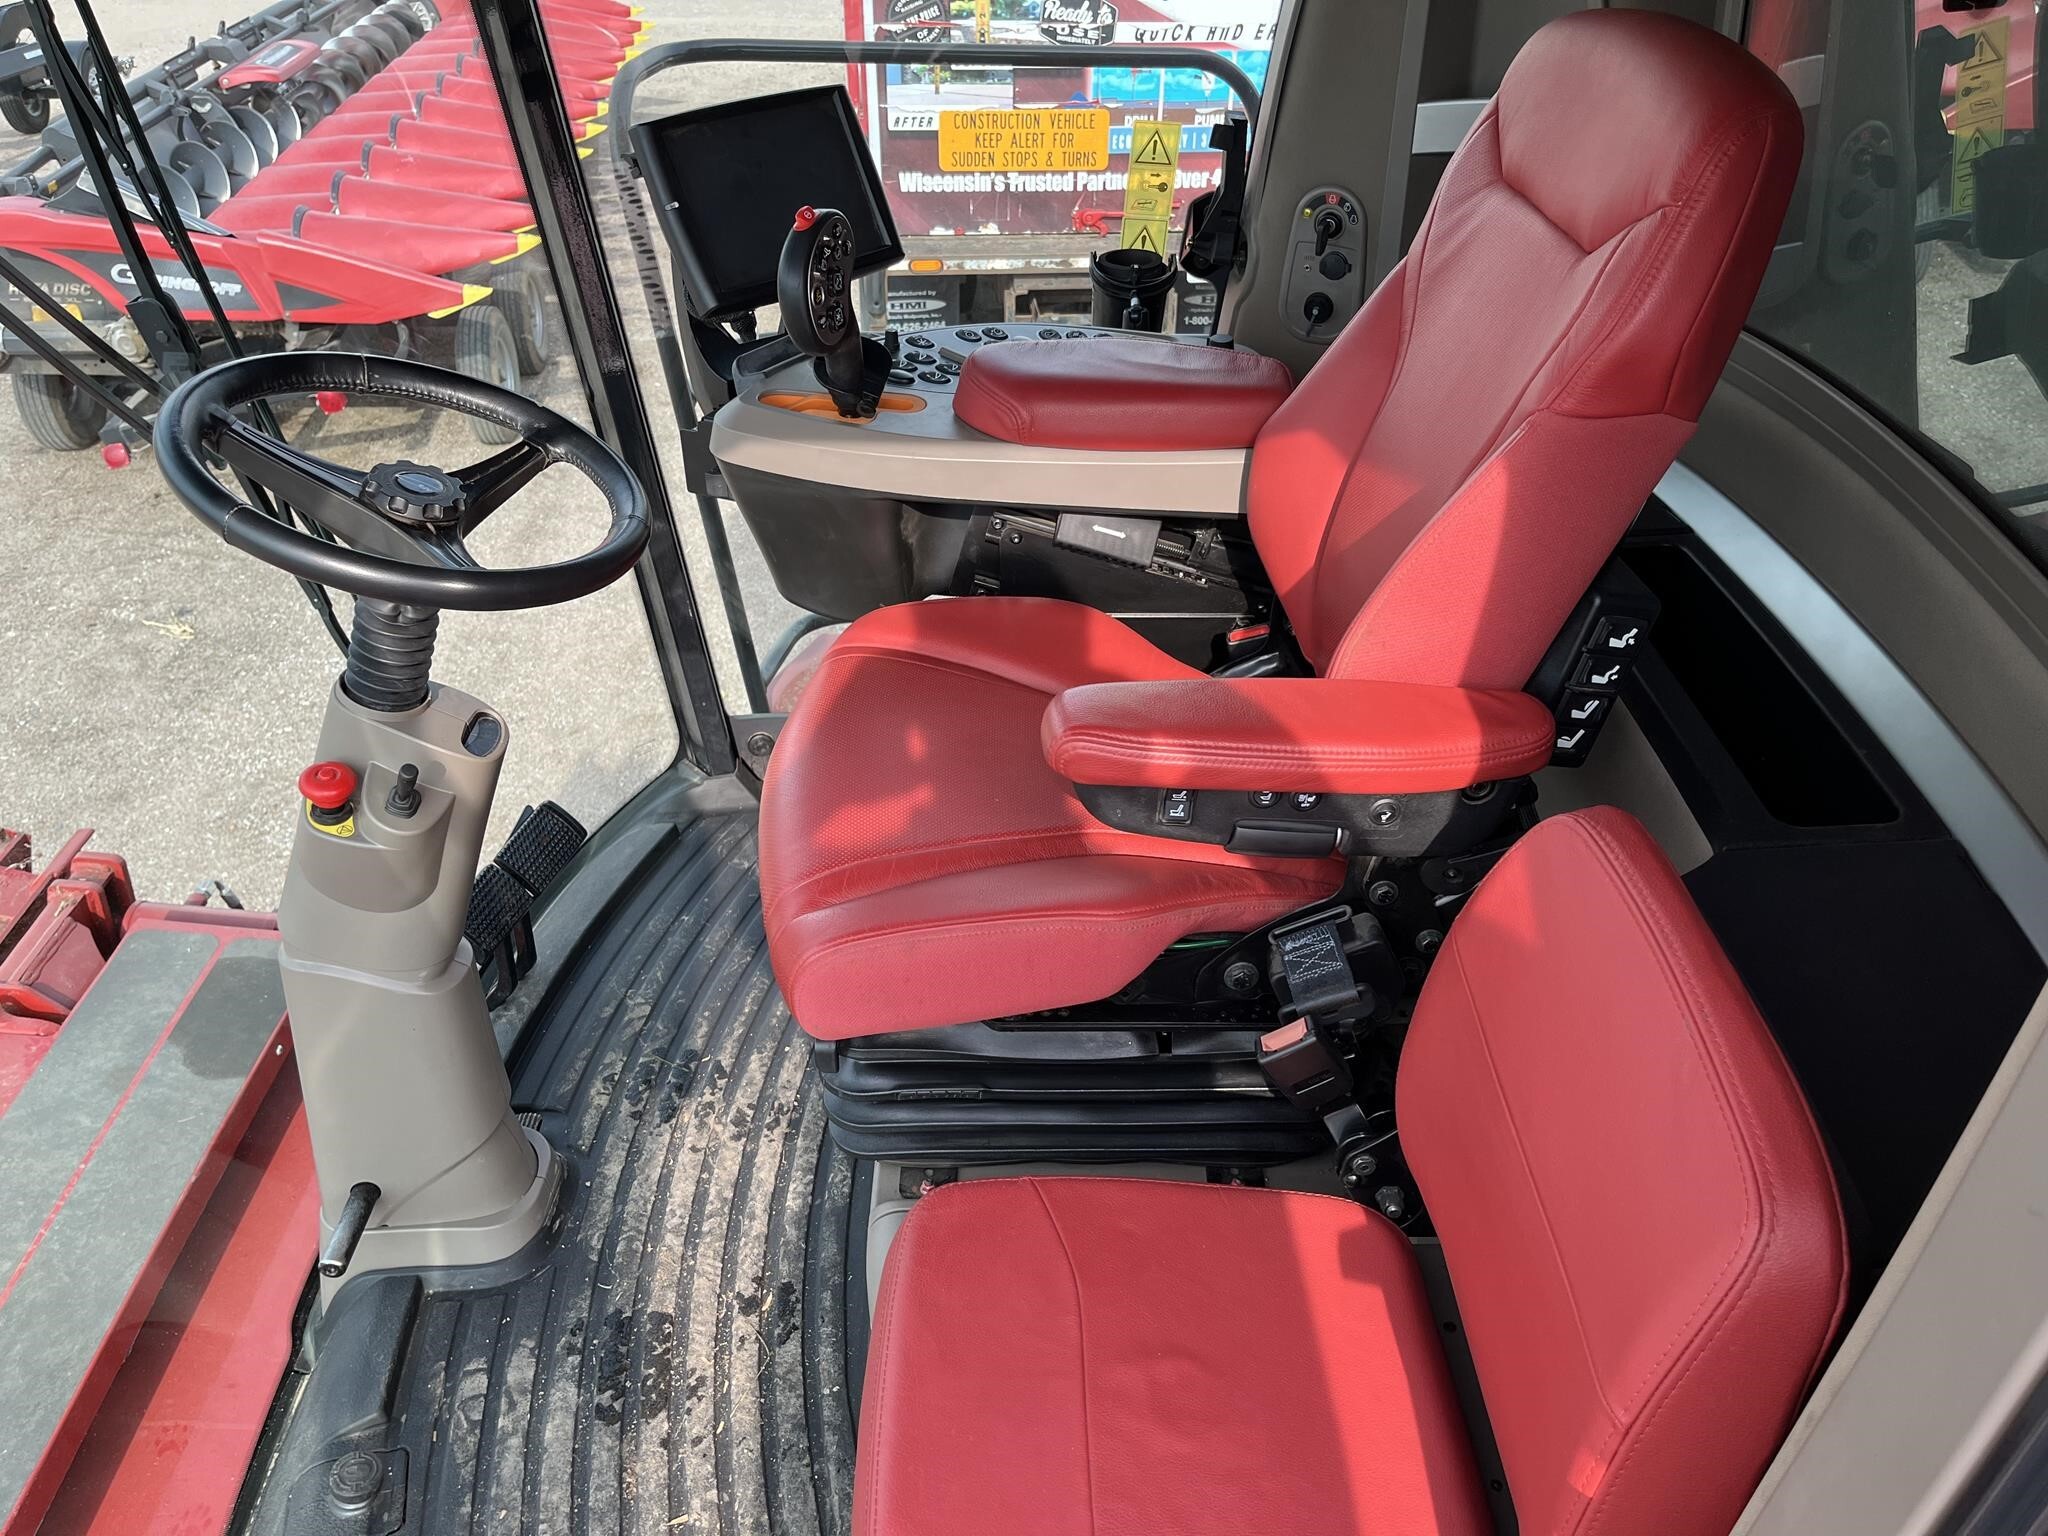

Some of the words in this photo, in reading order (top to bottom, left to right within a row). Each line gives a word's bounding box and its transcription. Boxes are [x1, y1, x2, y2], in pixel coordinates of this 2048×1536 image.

[919, 5, 941, 20] PRICE
[1044, 0, 1094, 25] Ready
[1097, 3, 1114, 26] to
[917, 28, 929, 39] OF
[1135, 24, 1196, 43] QUICK
[1253, 23, 1277, 41] EA
[894, 116, 934, 127] AFTER
[954, 113, 1040, 130] CONSTRUCTION
[1050, 113, 1096, 130] VEHICLE
[975, 132, 1003, 148] KEEP
[1010, 132, 1045, 148] ALERT
[1053, 132, 1074, 148] FOR
[951, 151, 995, 167] SUDDEN
[1003, 152, 1038, 168] STOPS
[1046, 152, 1053, 167] &
[1062, 151, 1097, 167] TURNS
[1007, 172, 1074, 192] Trusted
[53, 282, 92, 296] DISC
[890, 302, 927, 310] HMI
